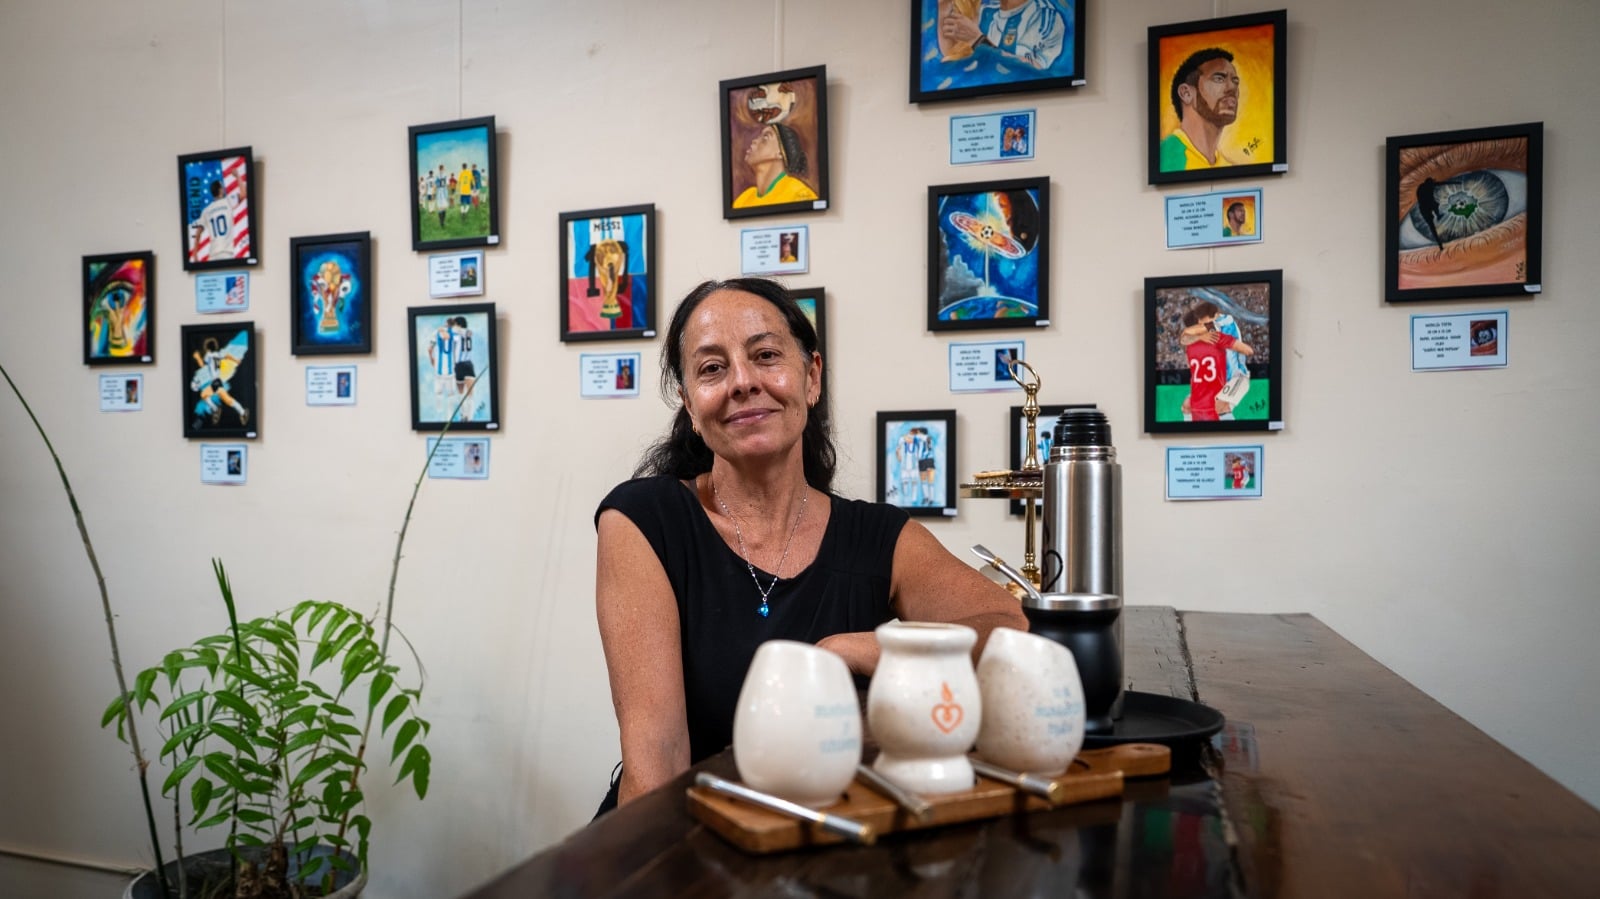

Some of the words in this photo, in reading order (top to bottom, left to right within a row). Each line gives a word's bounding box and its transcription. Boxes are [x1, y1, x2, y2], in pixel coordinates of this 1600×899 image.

[210, 214, 229, 239] 10
[593, 221, 622, 232] MESSI
[1190, 356, 1217, 383] 23
